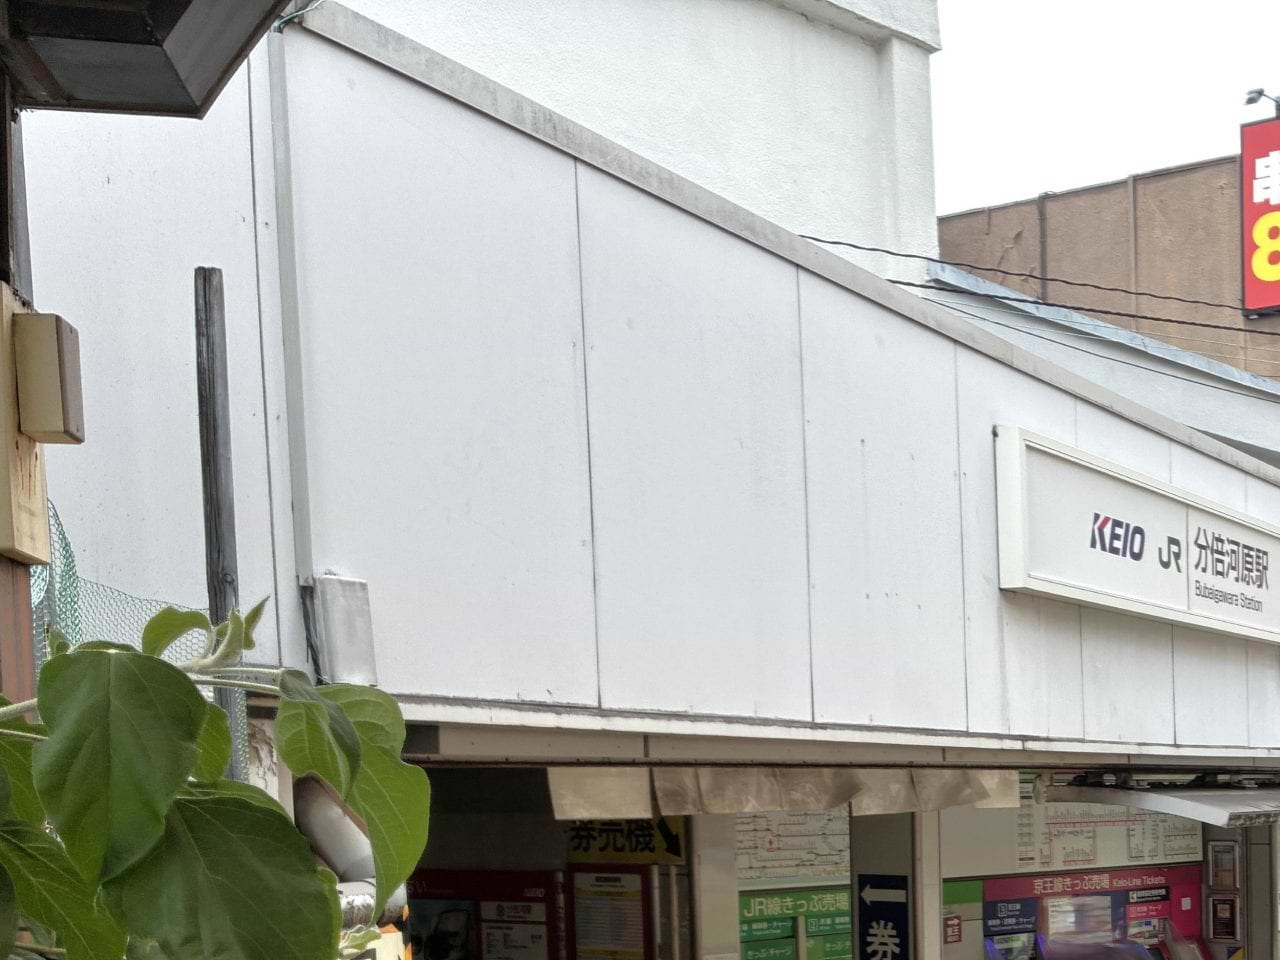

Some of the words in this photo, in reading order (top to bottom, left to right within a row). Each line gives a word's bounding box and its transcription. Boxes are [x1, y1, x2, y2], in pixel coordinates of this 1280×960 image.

[1089, 512, 1146, 562] KEIO
[1158, 536, 1183, 574] JR
[1194, 528, 1270, 589] 分倍河原駅
[1195, 580, 1239, 608] Bubaigawara
[1240, 592, 1263, 614] Station
[744, 893, 849, 917] JR線きっぷ売場
